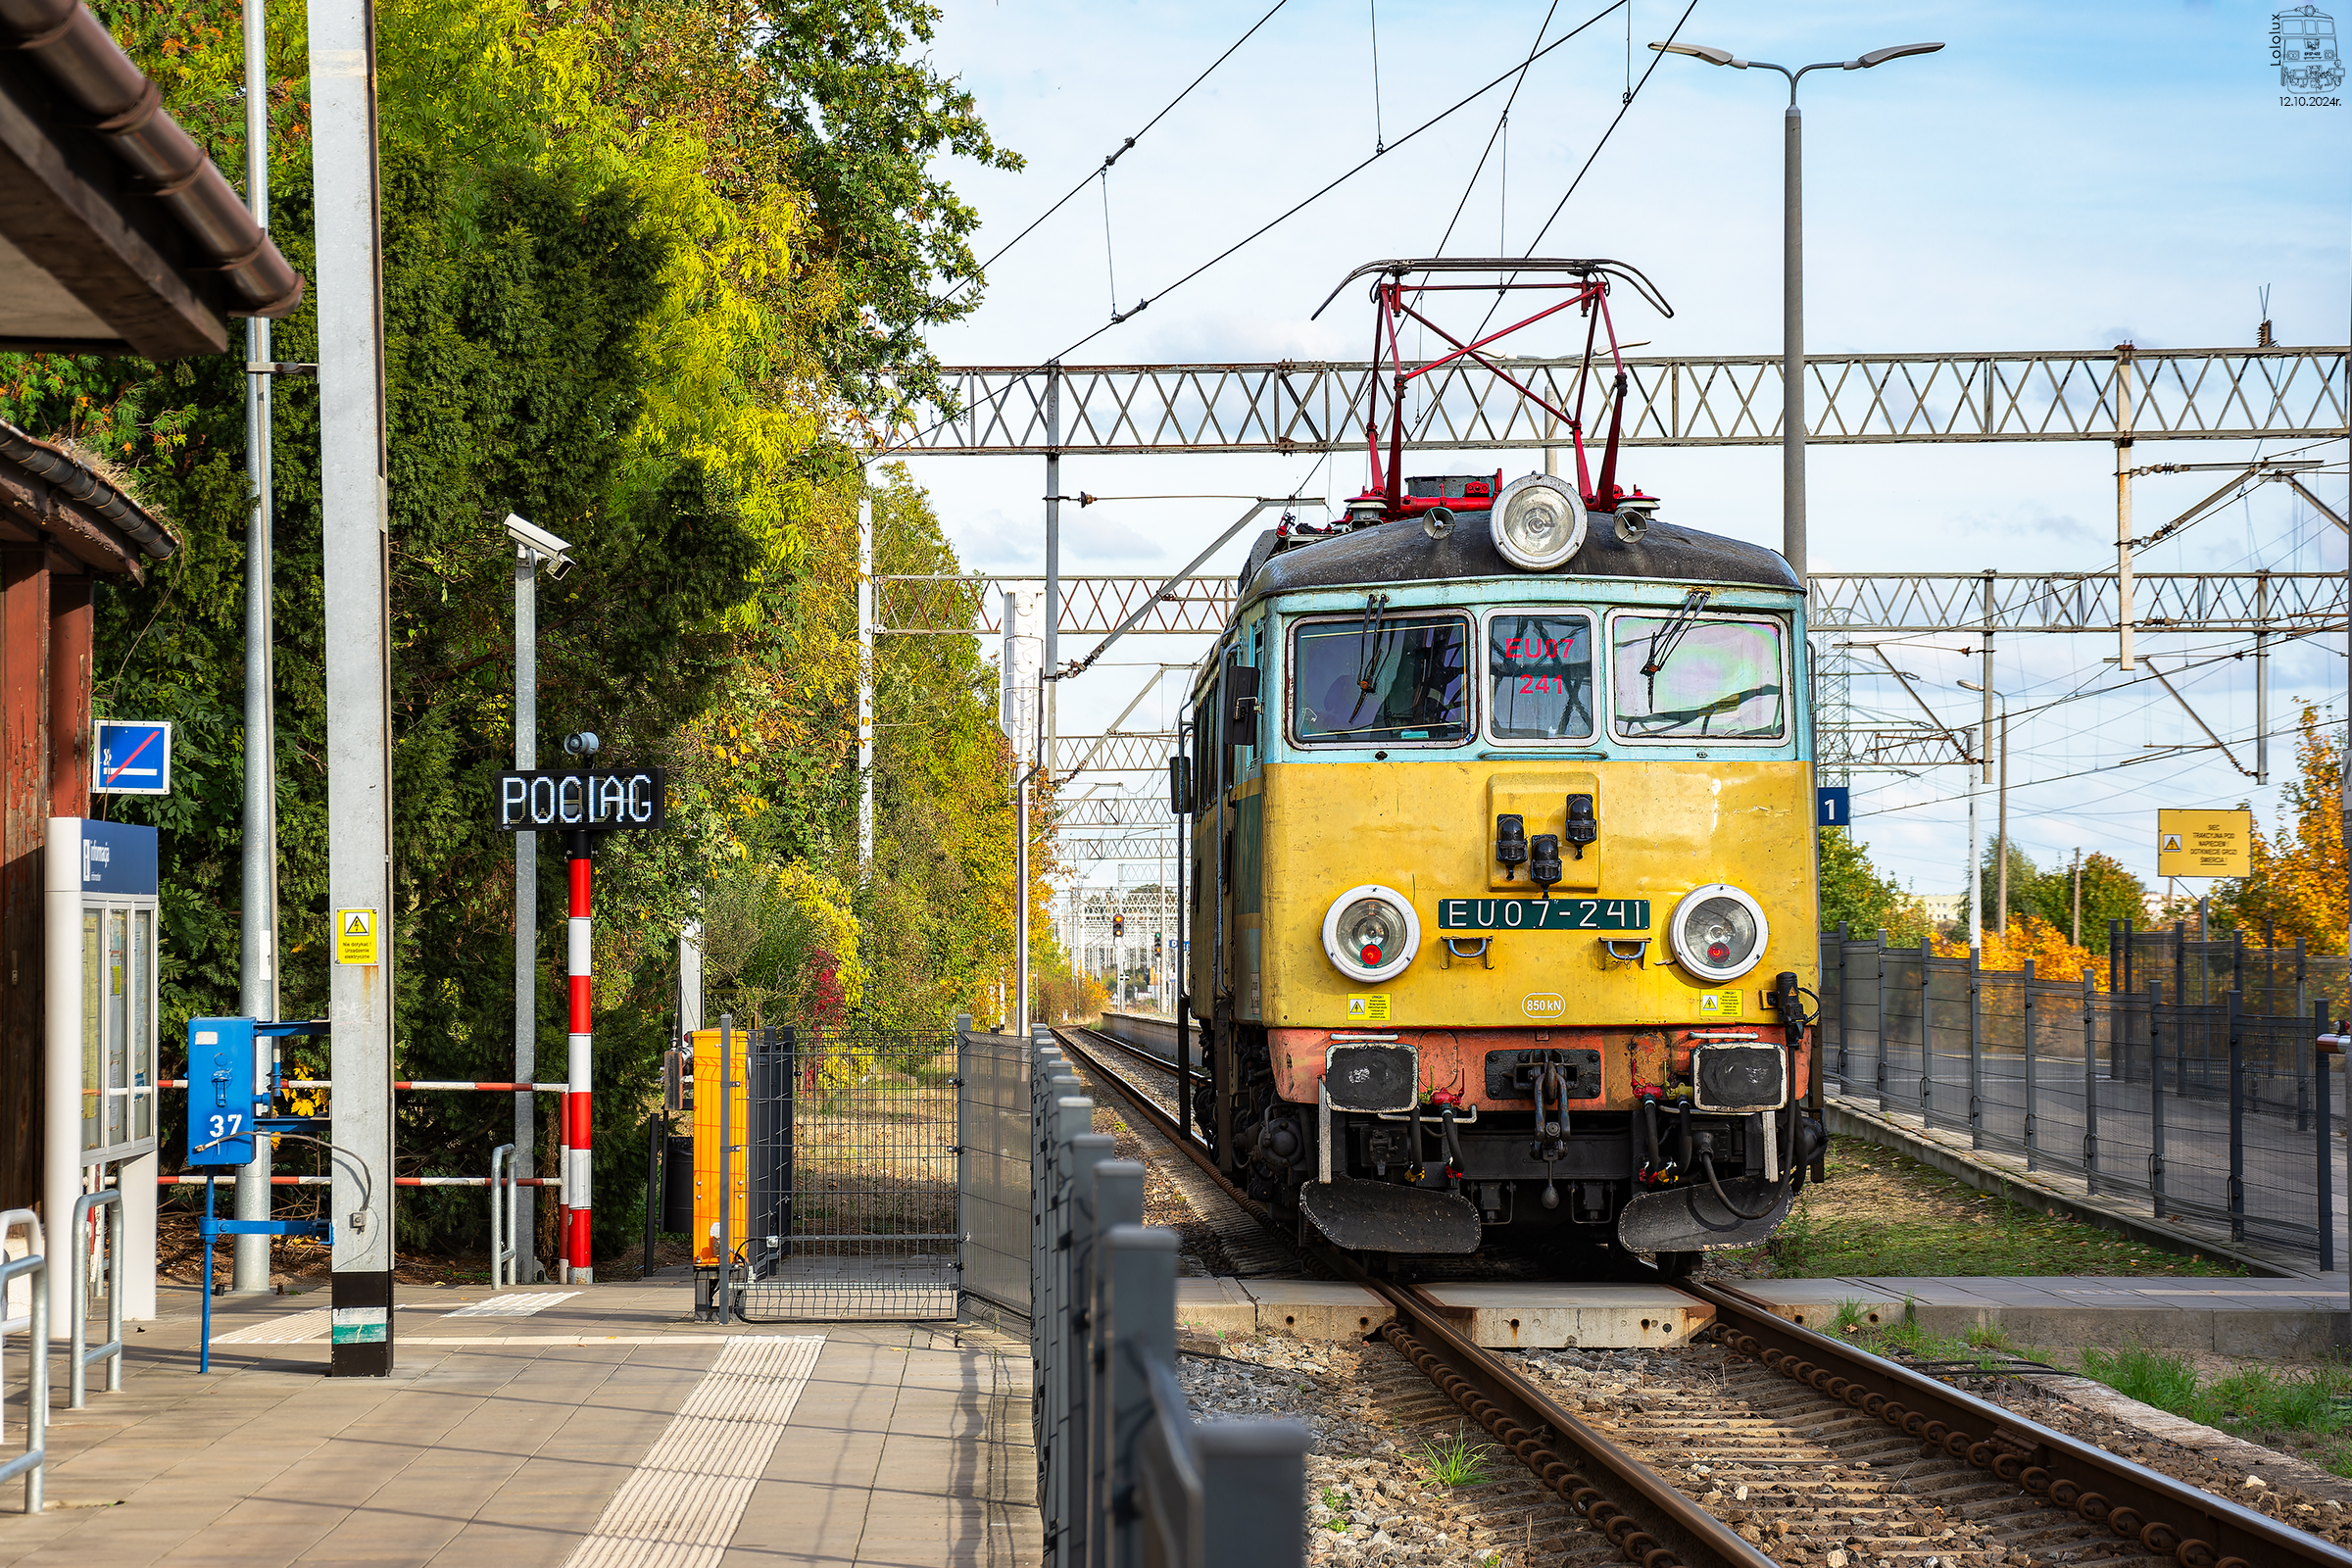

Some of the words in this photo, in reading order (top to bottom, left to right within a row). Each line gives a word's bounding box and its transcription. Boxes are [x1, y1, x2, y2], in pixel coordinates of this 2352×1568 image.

[1505, 638, 1574, 659] EU07
[1519, 673, 1562, 694] 241
[1824, 799, 1835, 820] 1
[1448, 900, 1641, 927] EU07-241
[1526, 1000, 1545, 1010] 850
[1547, 1000, 1561, 1010] kN
[209, 1114, 242, 1138] 37
